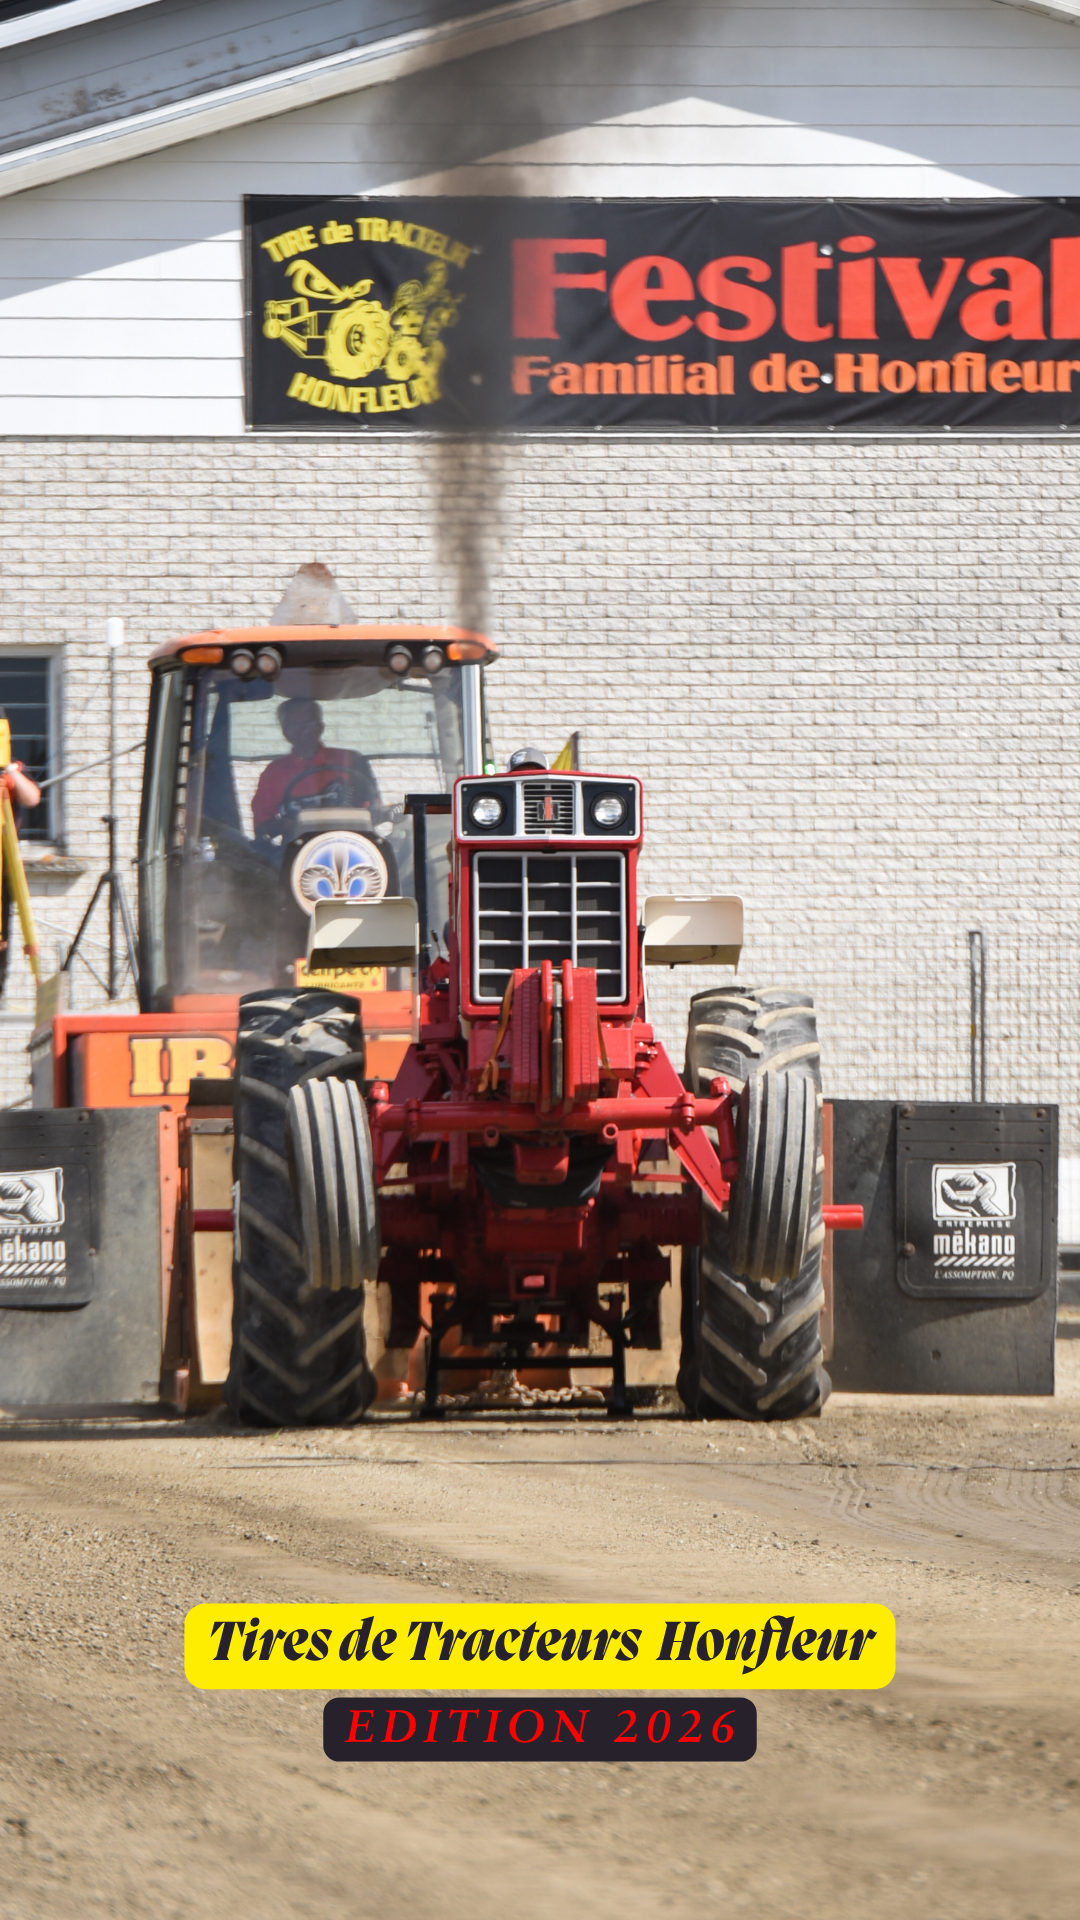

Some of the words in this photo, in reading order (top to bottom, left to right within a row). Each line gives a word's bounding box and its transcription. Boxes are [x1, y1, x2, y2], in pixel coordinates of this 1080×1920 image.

[261, 226, 318, 262] TIRE
[320, 221, 354, 244] de
[356, 217, 471, 269] TRACTEUR
[512, 235, 1080, 342] Festival
[286, 372, 443, 413] HONFLEUR
[512, 354, 735, 395] Familial
[750, 353, 820, 393] de
[834, 351, 1080, 393] Honfleur
[937, 1220, 1011, 1229] ENTREPRISE
[1002, 1269, 1015, 1281] PQ
